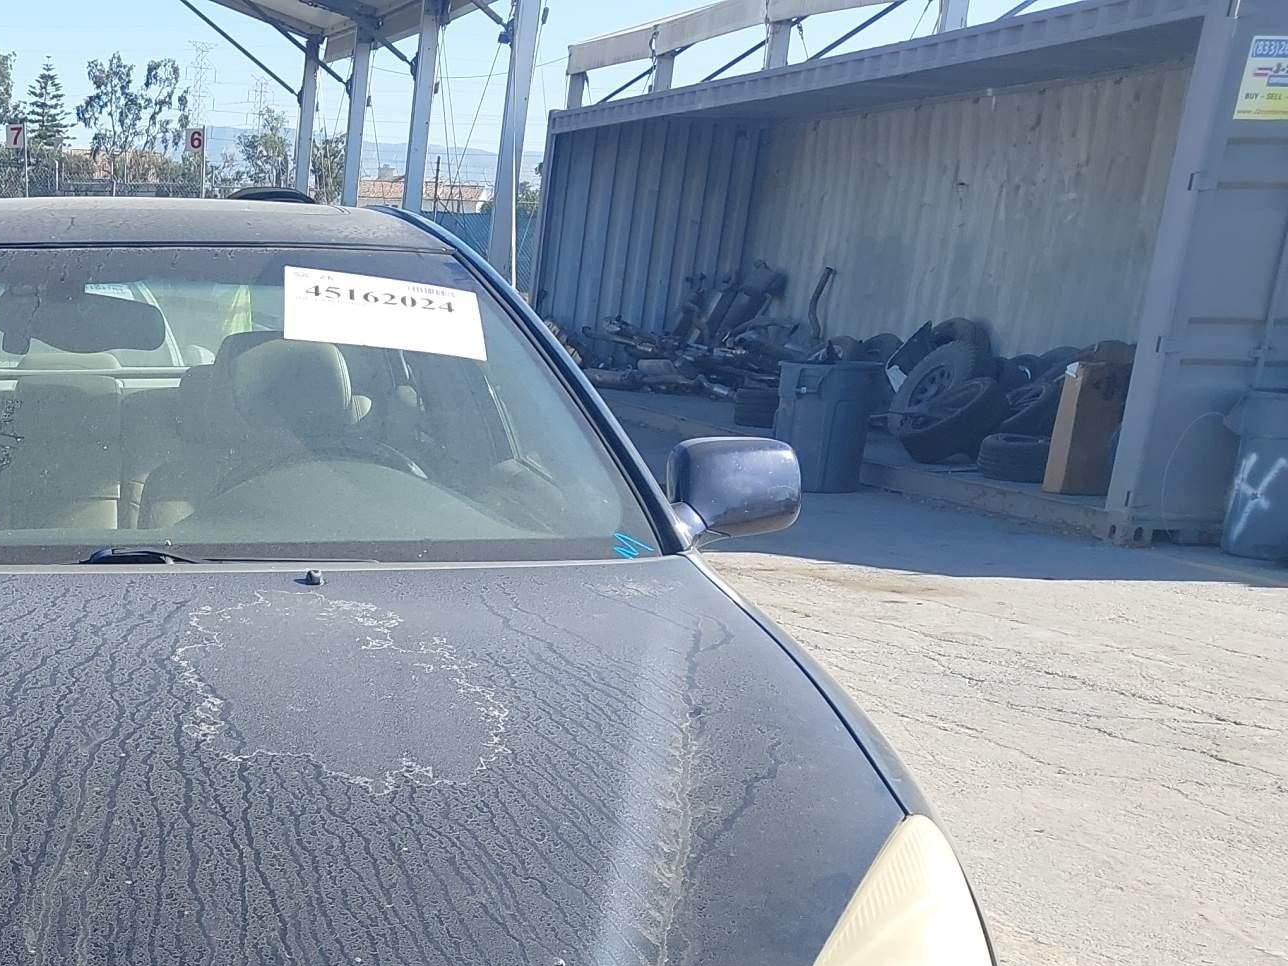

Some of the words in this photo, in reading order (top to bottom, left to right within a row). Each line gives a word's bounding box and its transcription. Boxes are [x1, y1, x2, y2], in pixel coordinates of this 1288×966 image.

[1245, 92, 1261, 100] BUY
[9, 126, 23, 145] 7
[190, 131, 202, 149] 6
[305, 284, 455, 314] 45162024
